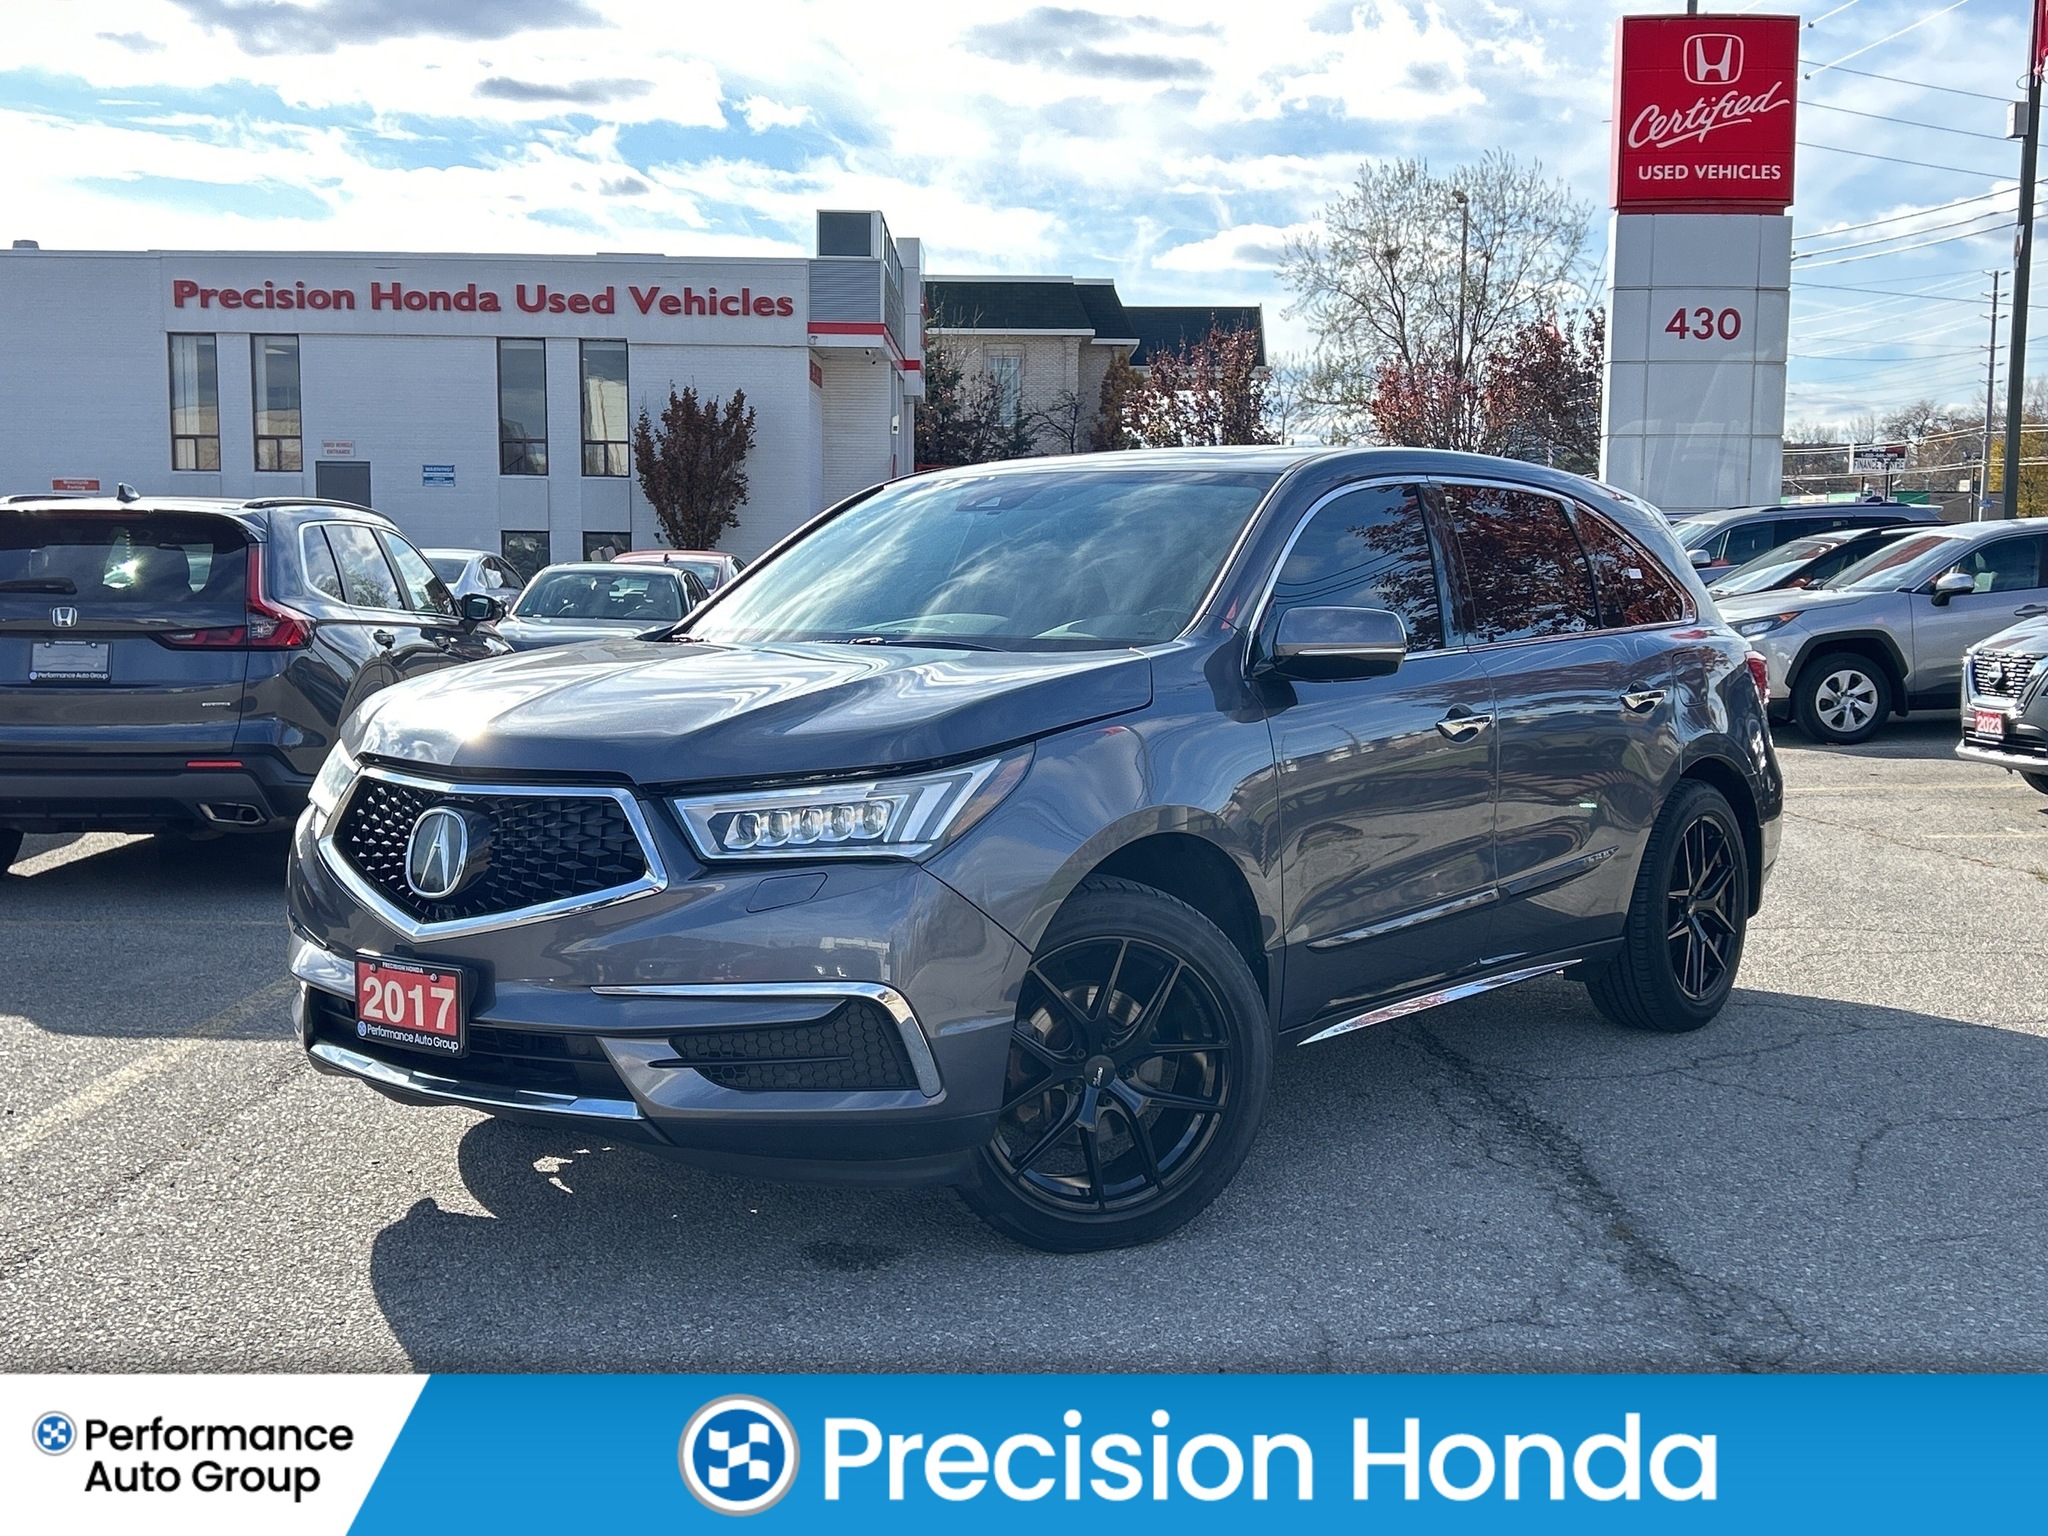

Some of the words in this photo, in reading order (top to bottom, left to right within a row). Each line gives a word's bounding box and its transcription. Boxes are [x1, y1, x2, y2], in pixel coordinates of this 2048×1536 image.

[1628, 81, 1790, 148] Certified
[1639, 164, 1689, 180] USED
[1694, 164, 1781, 180] VEHICLES
[173, 279, 355, 310] Precision
[371, 282, 501, 312] Honda
[515, 284, 616, 313] Used
[628, 286, 795, 317] Vehicles
[1665, 307, 1742, 341] 430
[89, 672, 109, 680] Group
[1977, 715, 2003, 735] 2023
[405, 966, 424, 974] HONDA
[363, 976, 455, 1030] 2017
[367, 1023, 414, 1043] Performance
[414, 1033, 433, 1047] Auto
[433, 1036, 459, 1053] Group
